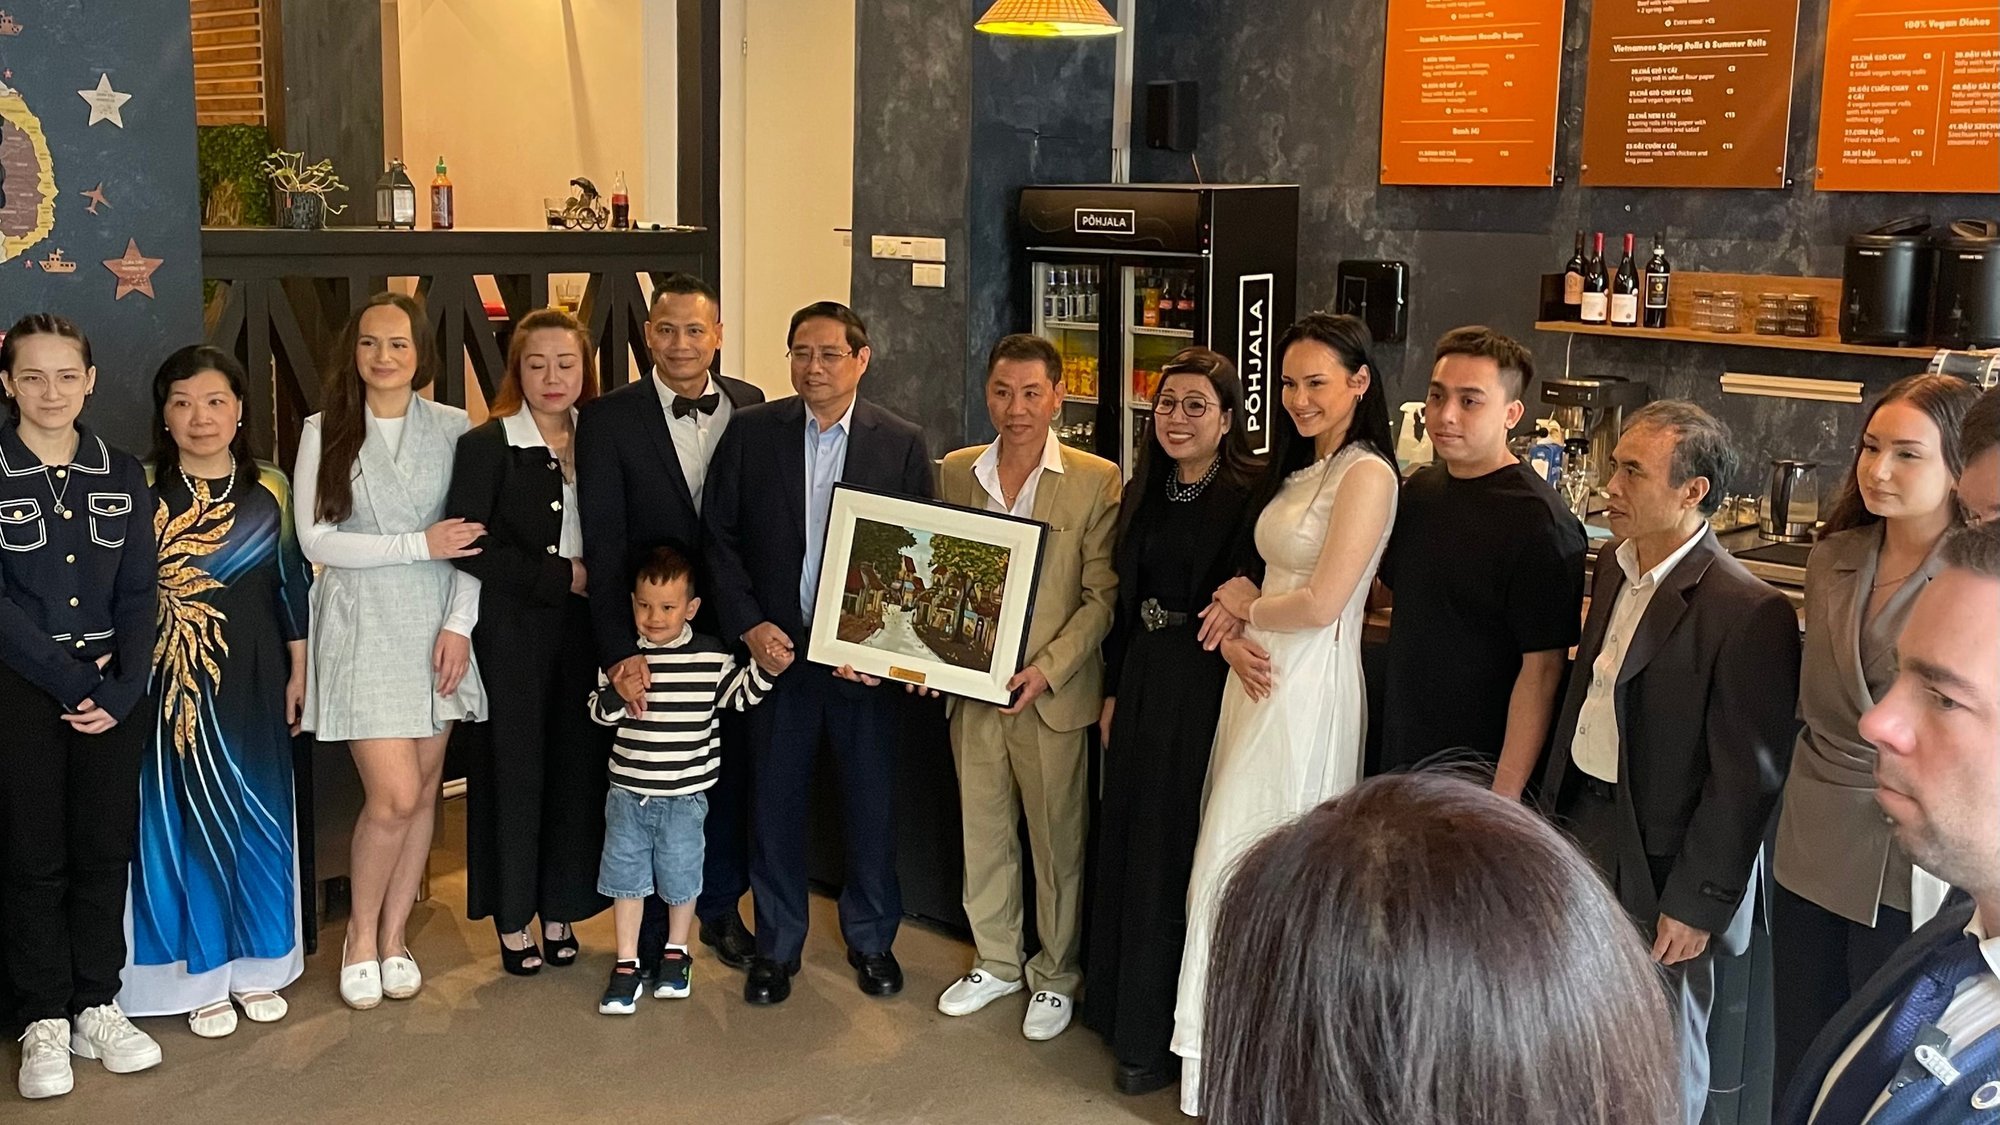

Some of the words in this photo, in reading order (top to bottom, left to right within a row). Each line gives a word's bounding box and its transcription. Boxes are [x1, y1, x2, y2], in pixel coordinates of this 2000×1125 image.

[1928, 19, 1958, 30] Vegan
[1959, 17, 1991, 26] Dishes
[1613, 44, 1656, 52] Vietnamese
[1658, 42, 1683, 52] Spring
[1684, 41, 1703, 50] Rolls
[1712, 40, 1746, 48] Summer
[1747, 38, 1766, 47] Rolls
[1082, 214, 1127, 228] PÕHJALA
[1246, 298, 1264, 432] PÕHJALA
